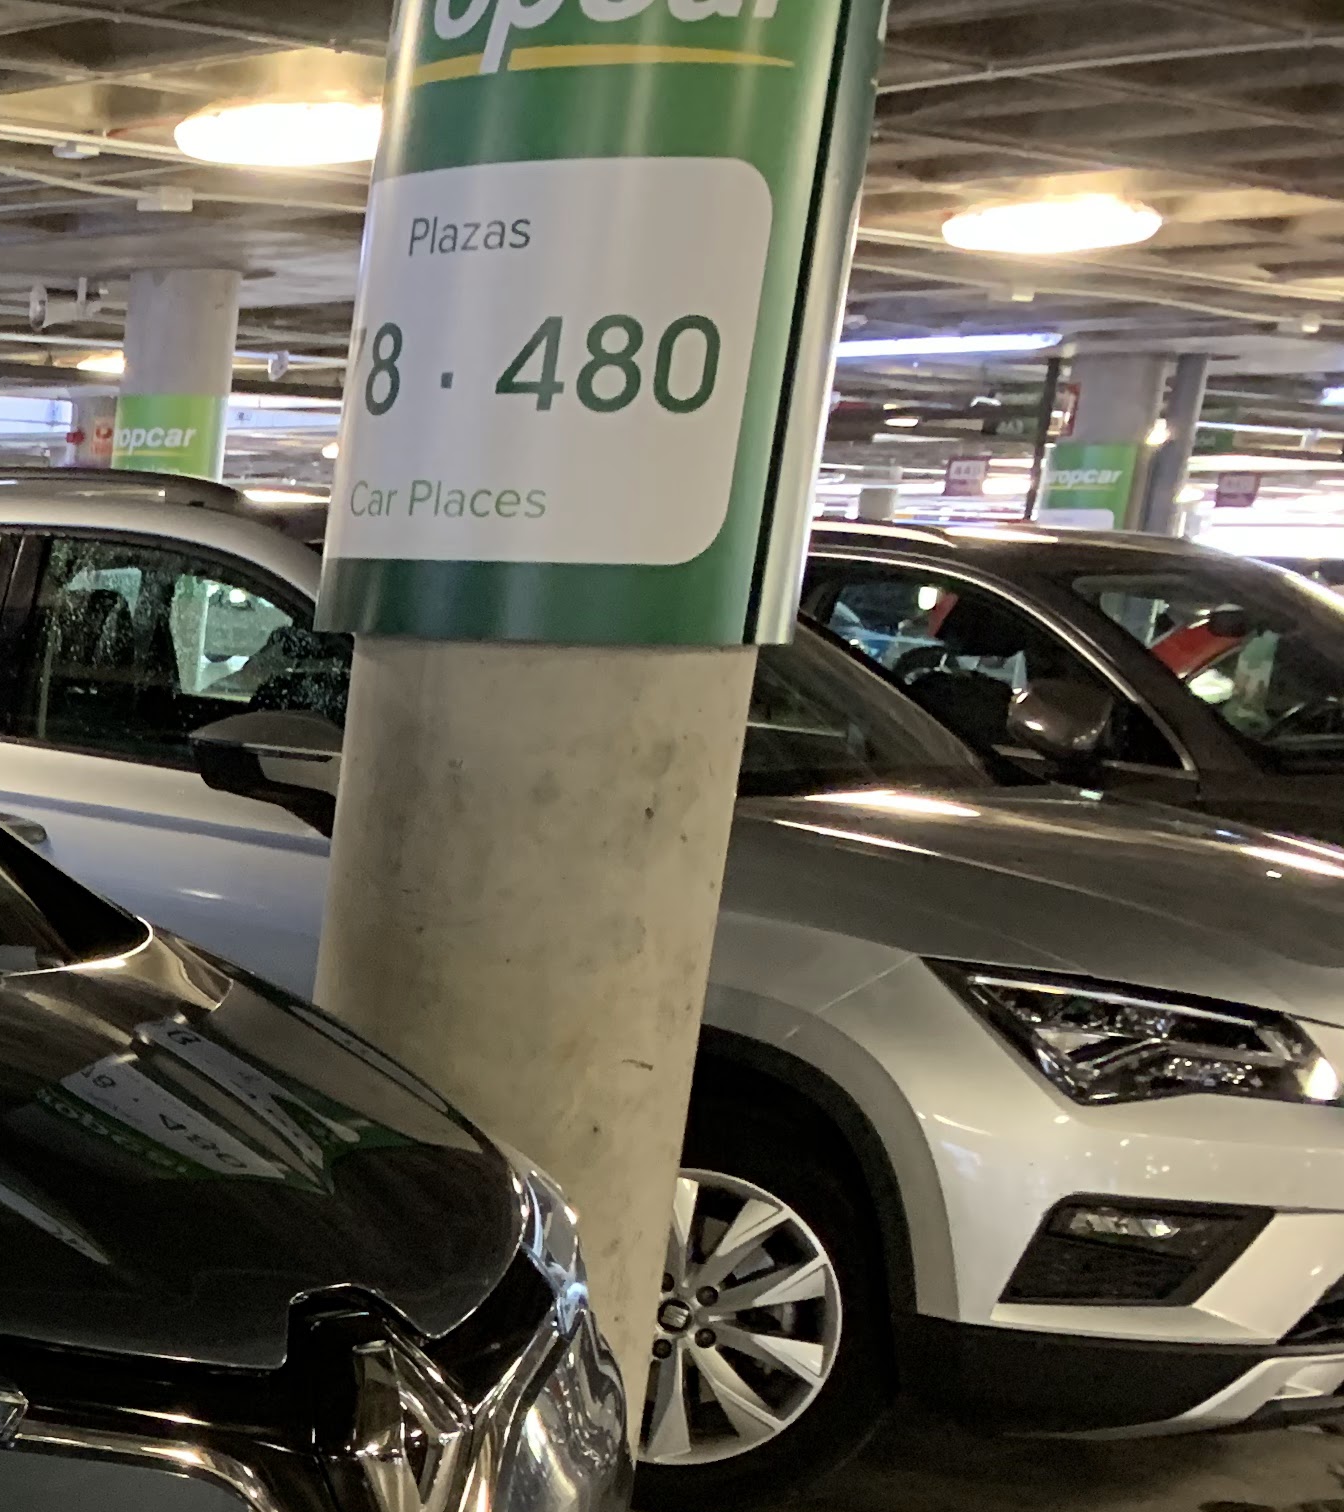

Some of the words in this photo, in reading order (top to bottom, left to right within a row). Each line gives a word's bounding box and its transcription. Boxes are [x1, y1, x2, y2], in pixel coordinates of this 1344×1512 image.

[408, 216, 531, 256] Plazas
[495, 313, 721, 414] 480
[115, 427, 198, 455] opcar
[349, 479, 398, 518] Car
[407, 479, 548, 519] Places
